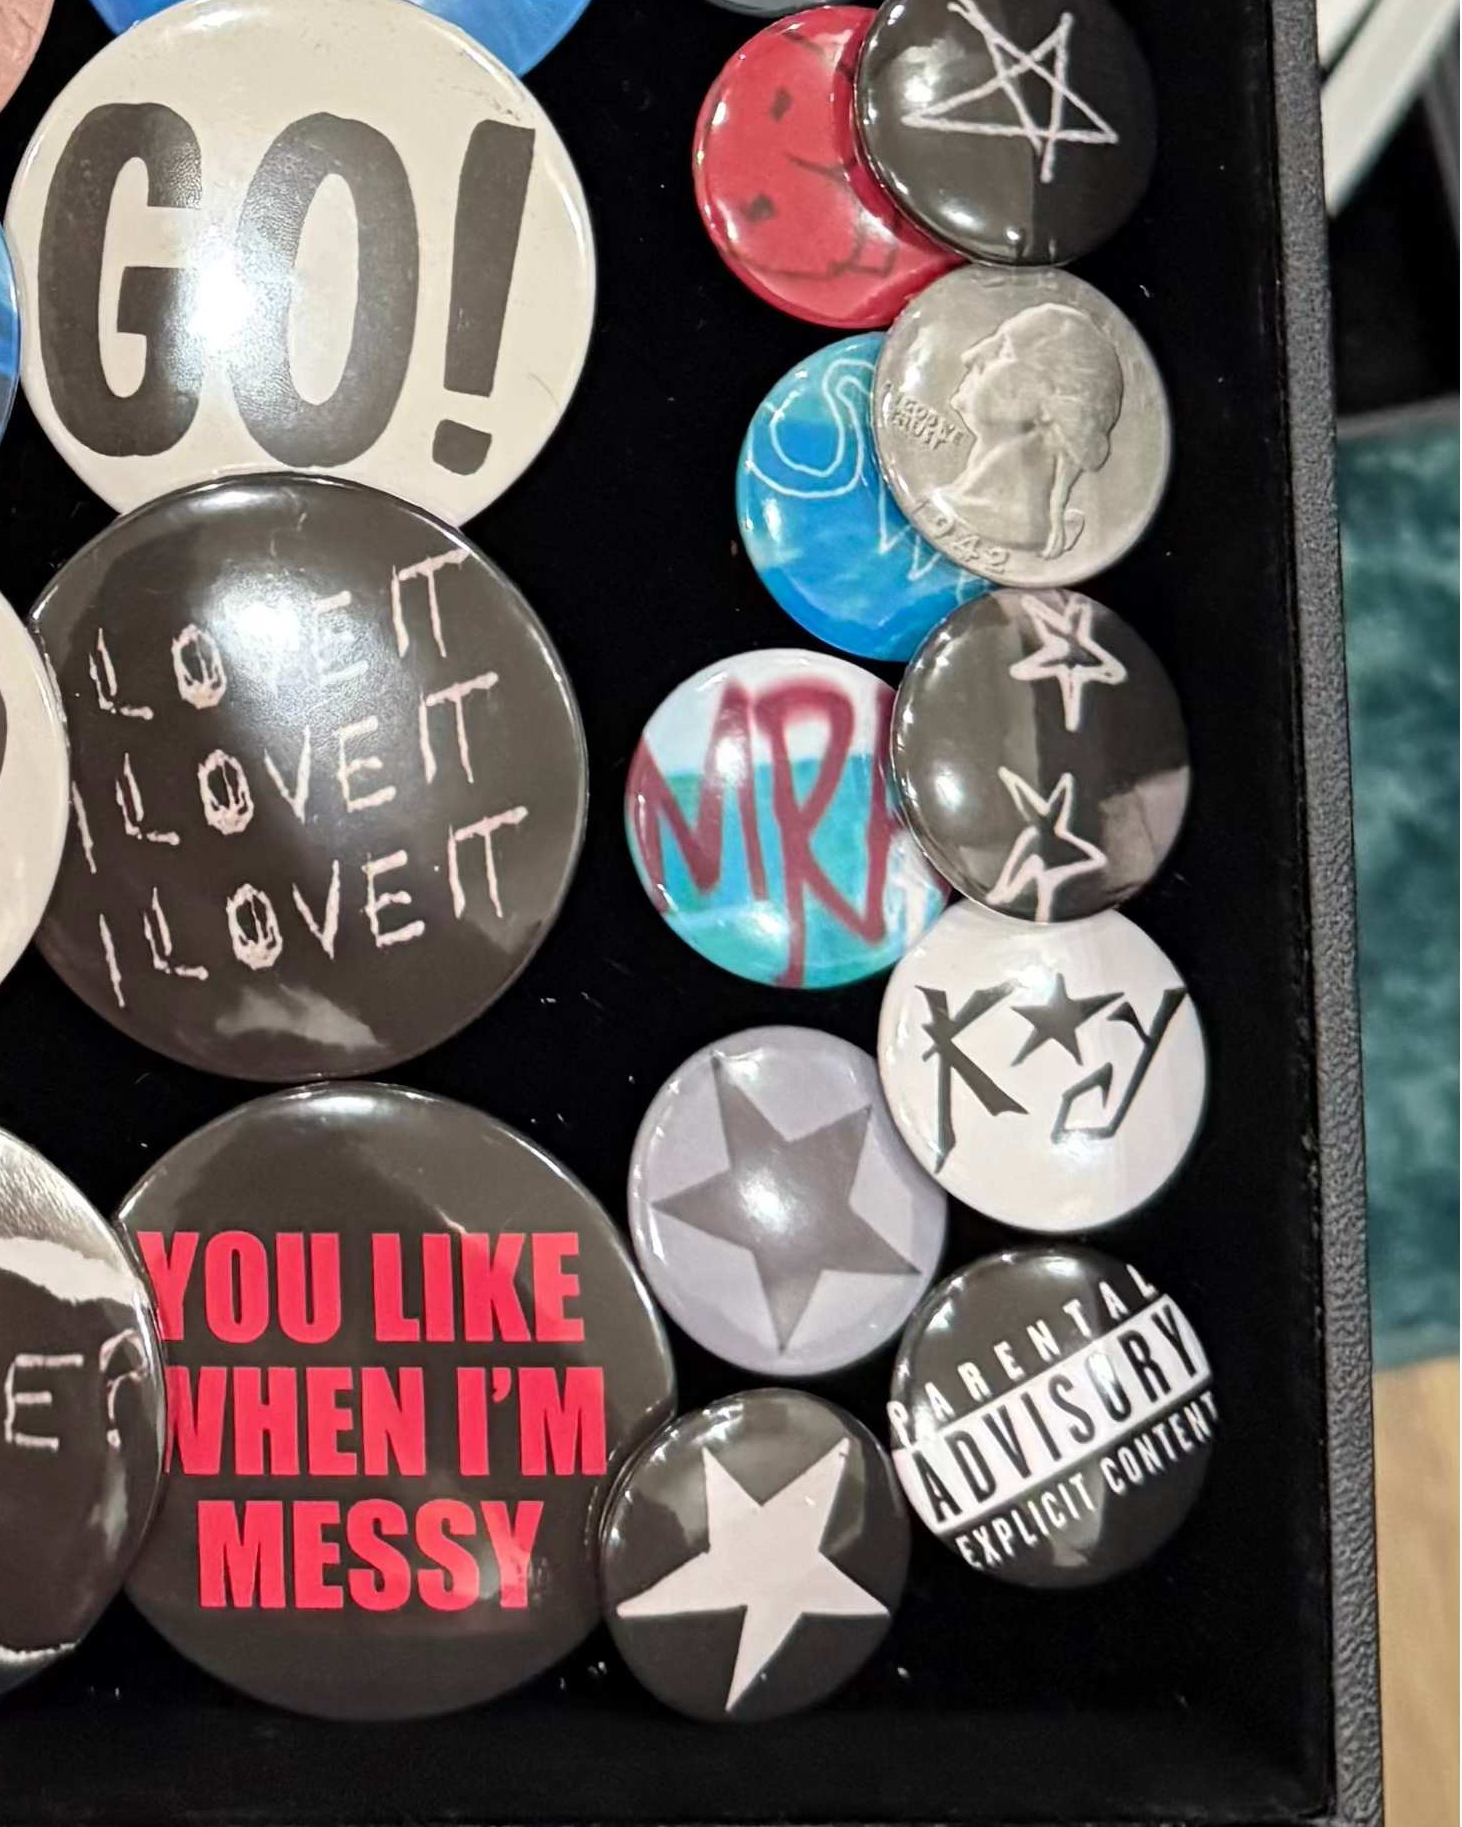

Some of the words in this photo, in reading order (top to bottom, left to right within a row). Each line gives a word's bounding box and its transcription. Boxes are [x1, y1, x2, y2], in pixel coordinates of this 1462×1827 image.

[38, 101, 536, 476] GO!
[912, 498, 1010, 575] 1942
[89, 589, 369, 721] LOE
[391, 547, 472, 659] IT
[70, 779, 97, 875] I
[115, 716, 397, 847] LOVE
[418, 670, 500, 785] IT
[99, 912, 126, 1009] I
[143, 849, 426, 981] LOVE
[448, 805, 529, 920] IT
[138, 1229, 343, 1345] YOU
[371, 1232, 586, 1342] LIKE
[886, 1263, 1159, 1451] PARENTAL
[164, 1366, 427, 1477] WHEN
[456, 1366, 608, 1477] I'M
[910, 1302, 1200, 1525] ADVISORY
[954, 1472, 1095, 1570] EXPLICIT
[1099, 1389, 1220, 1497] CONTENT
[197, 1498, 545, 1613] MESSY
